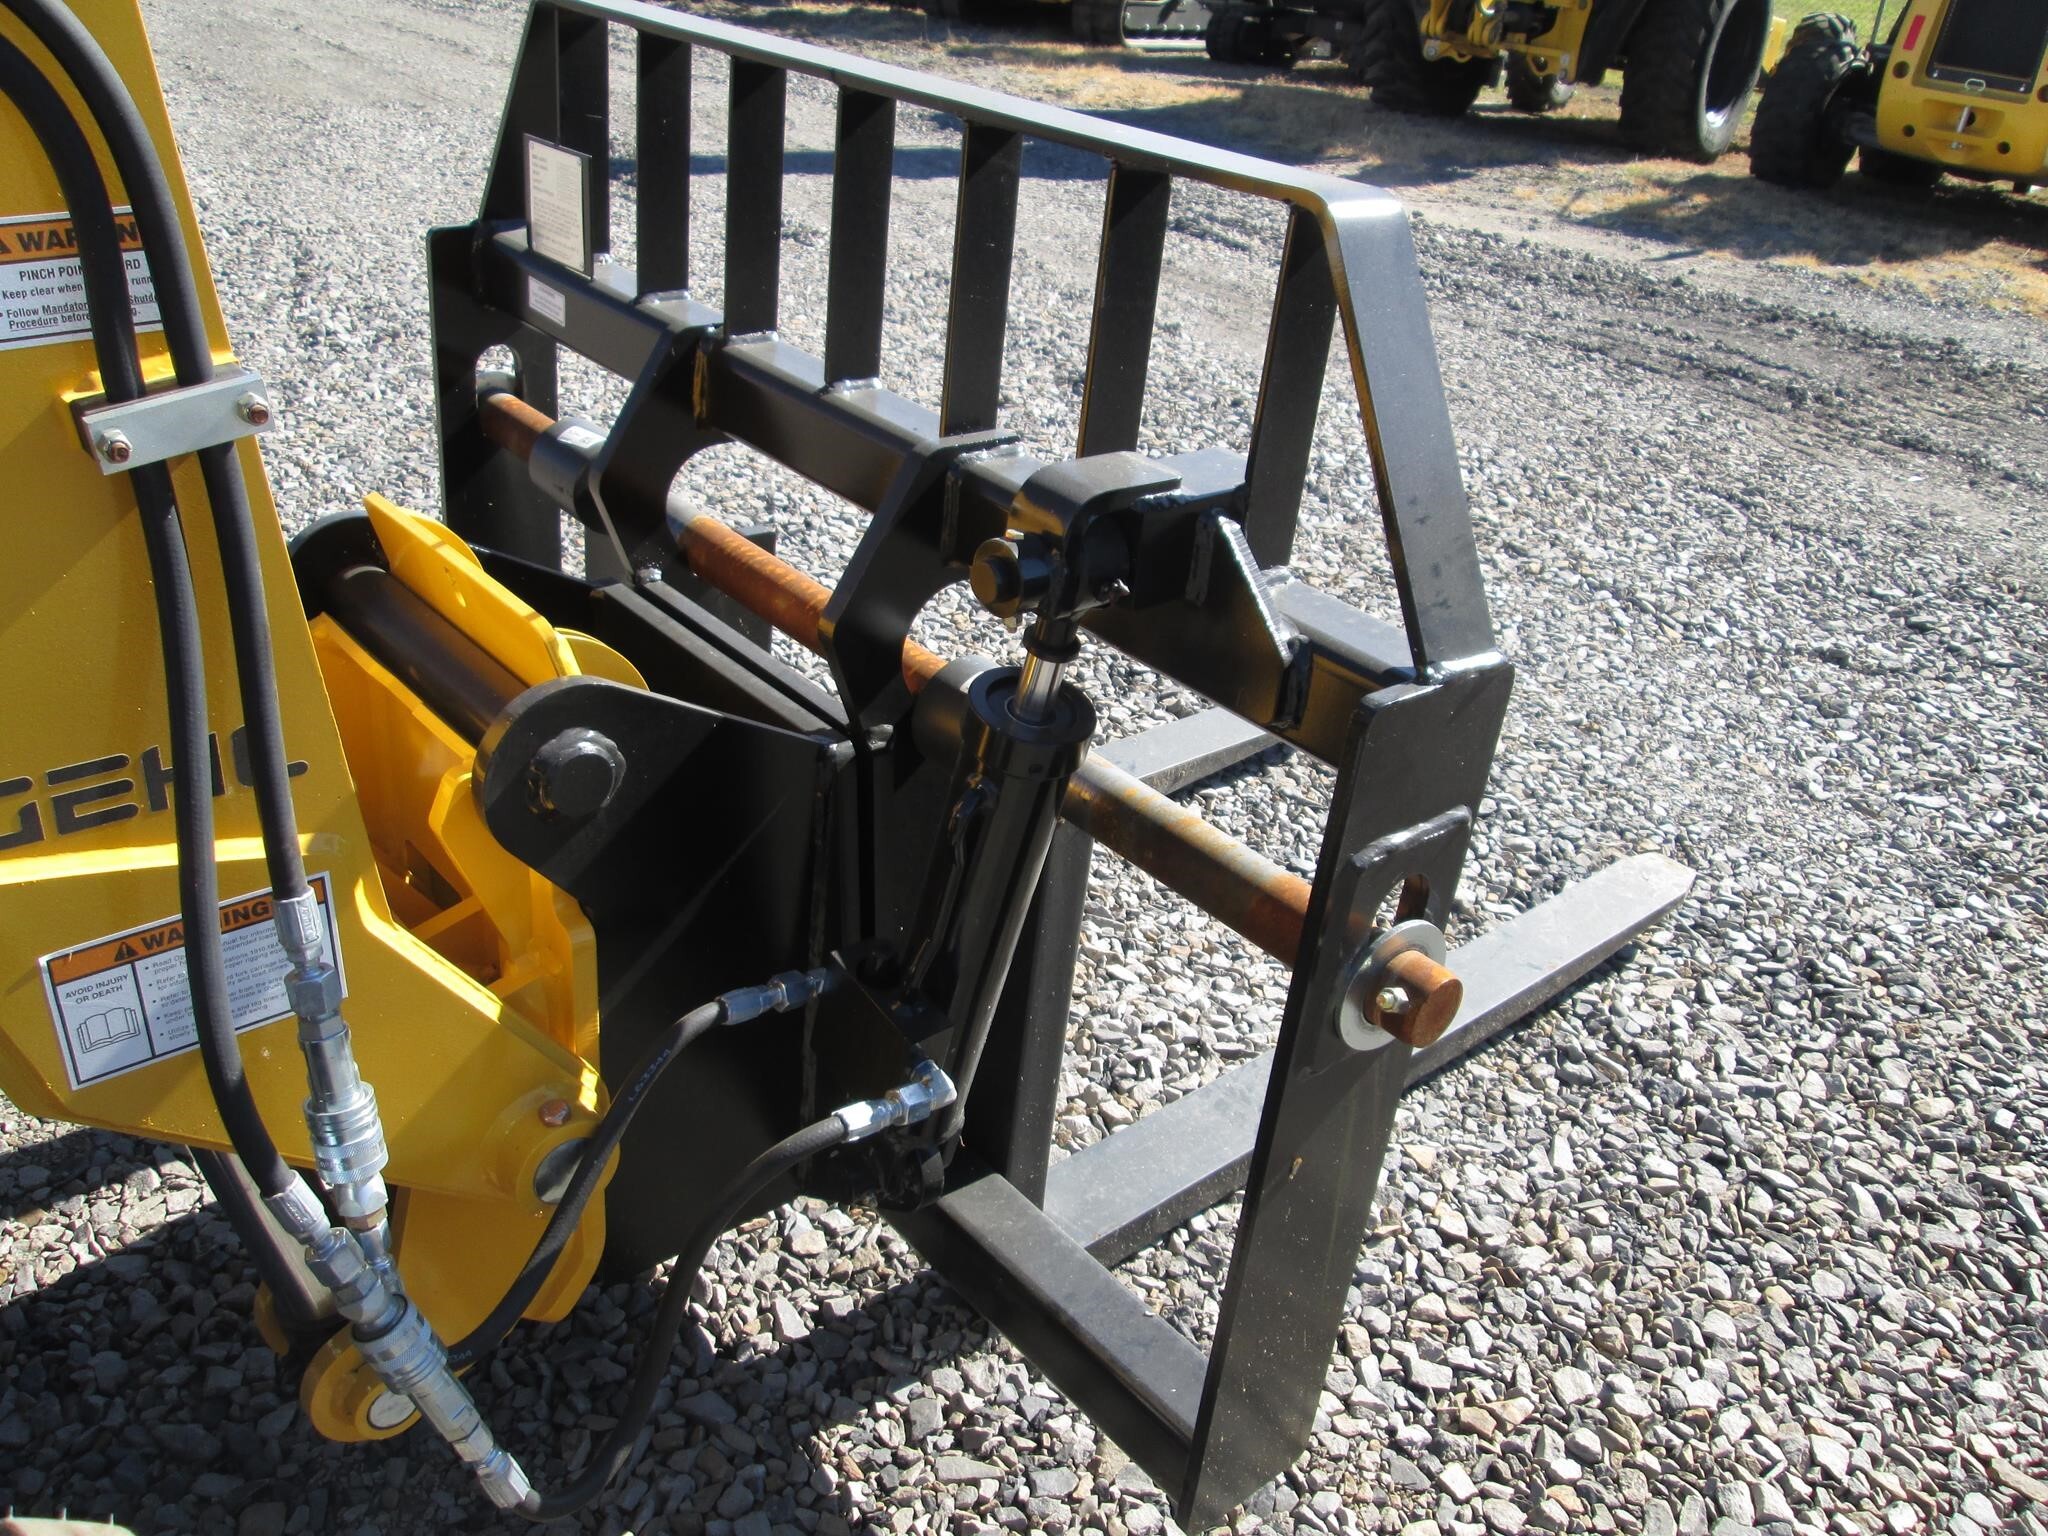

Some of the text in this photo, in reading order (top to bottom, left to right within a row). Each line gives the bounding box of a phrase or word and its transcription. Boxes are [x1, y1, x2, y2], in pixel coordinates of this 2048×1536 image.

[19, 268, 55, 281] PINCH
[2, 289, 27, 300] Keep
[30, 286, 55, 296] clear
[57, 283, 83, 293] when
[6, 308, 39, 319] Follow
[9, 315, 59, 331] Procedure
[65, 974, 129, 999] AVOID INJURY
[75, 984, 123, 1005] OR DEATH
